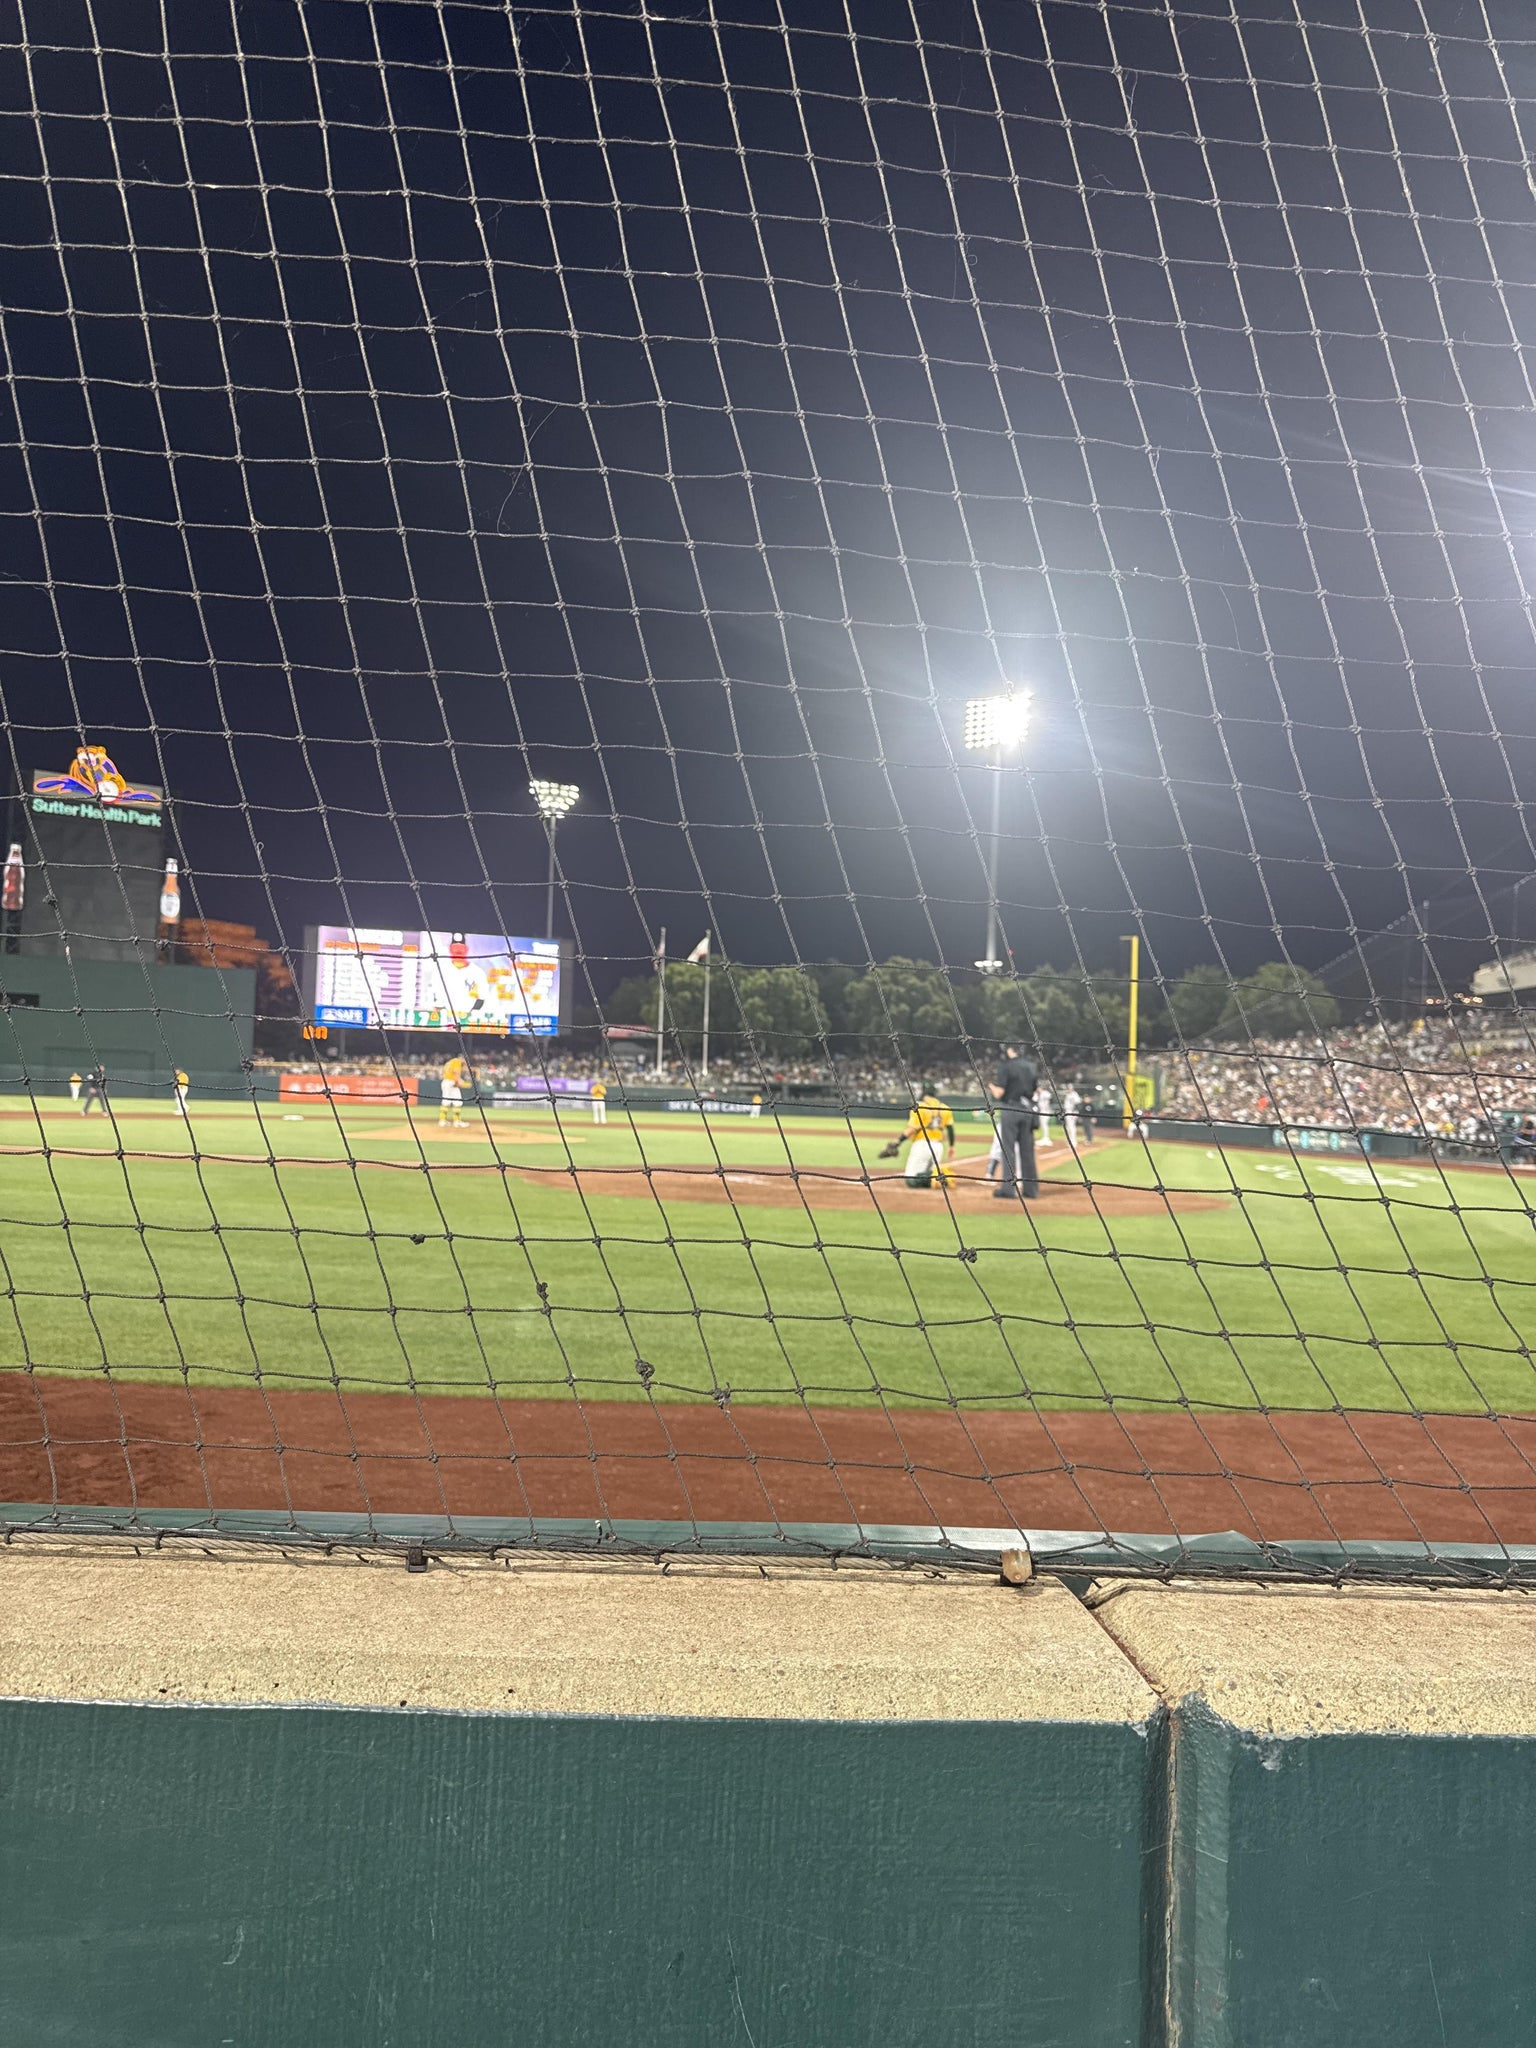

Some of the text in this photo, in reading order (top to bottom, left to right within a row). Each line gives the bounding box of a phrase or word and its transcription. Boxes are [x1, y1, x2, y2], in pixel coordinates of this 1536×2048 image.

[32, 799, 162, 828] Sutter Health Park
